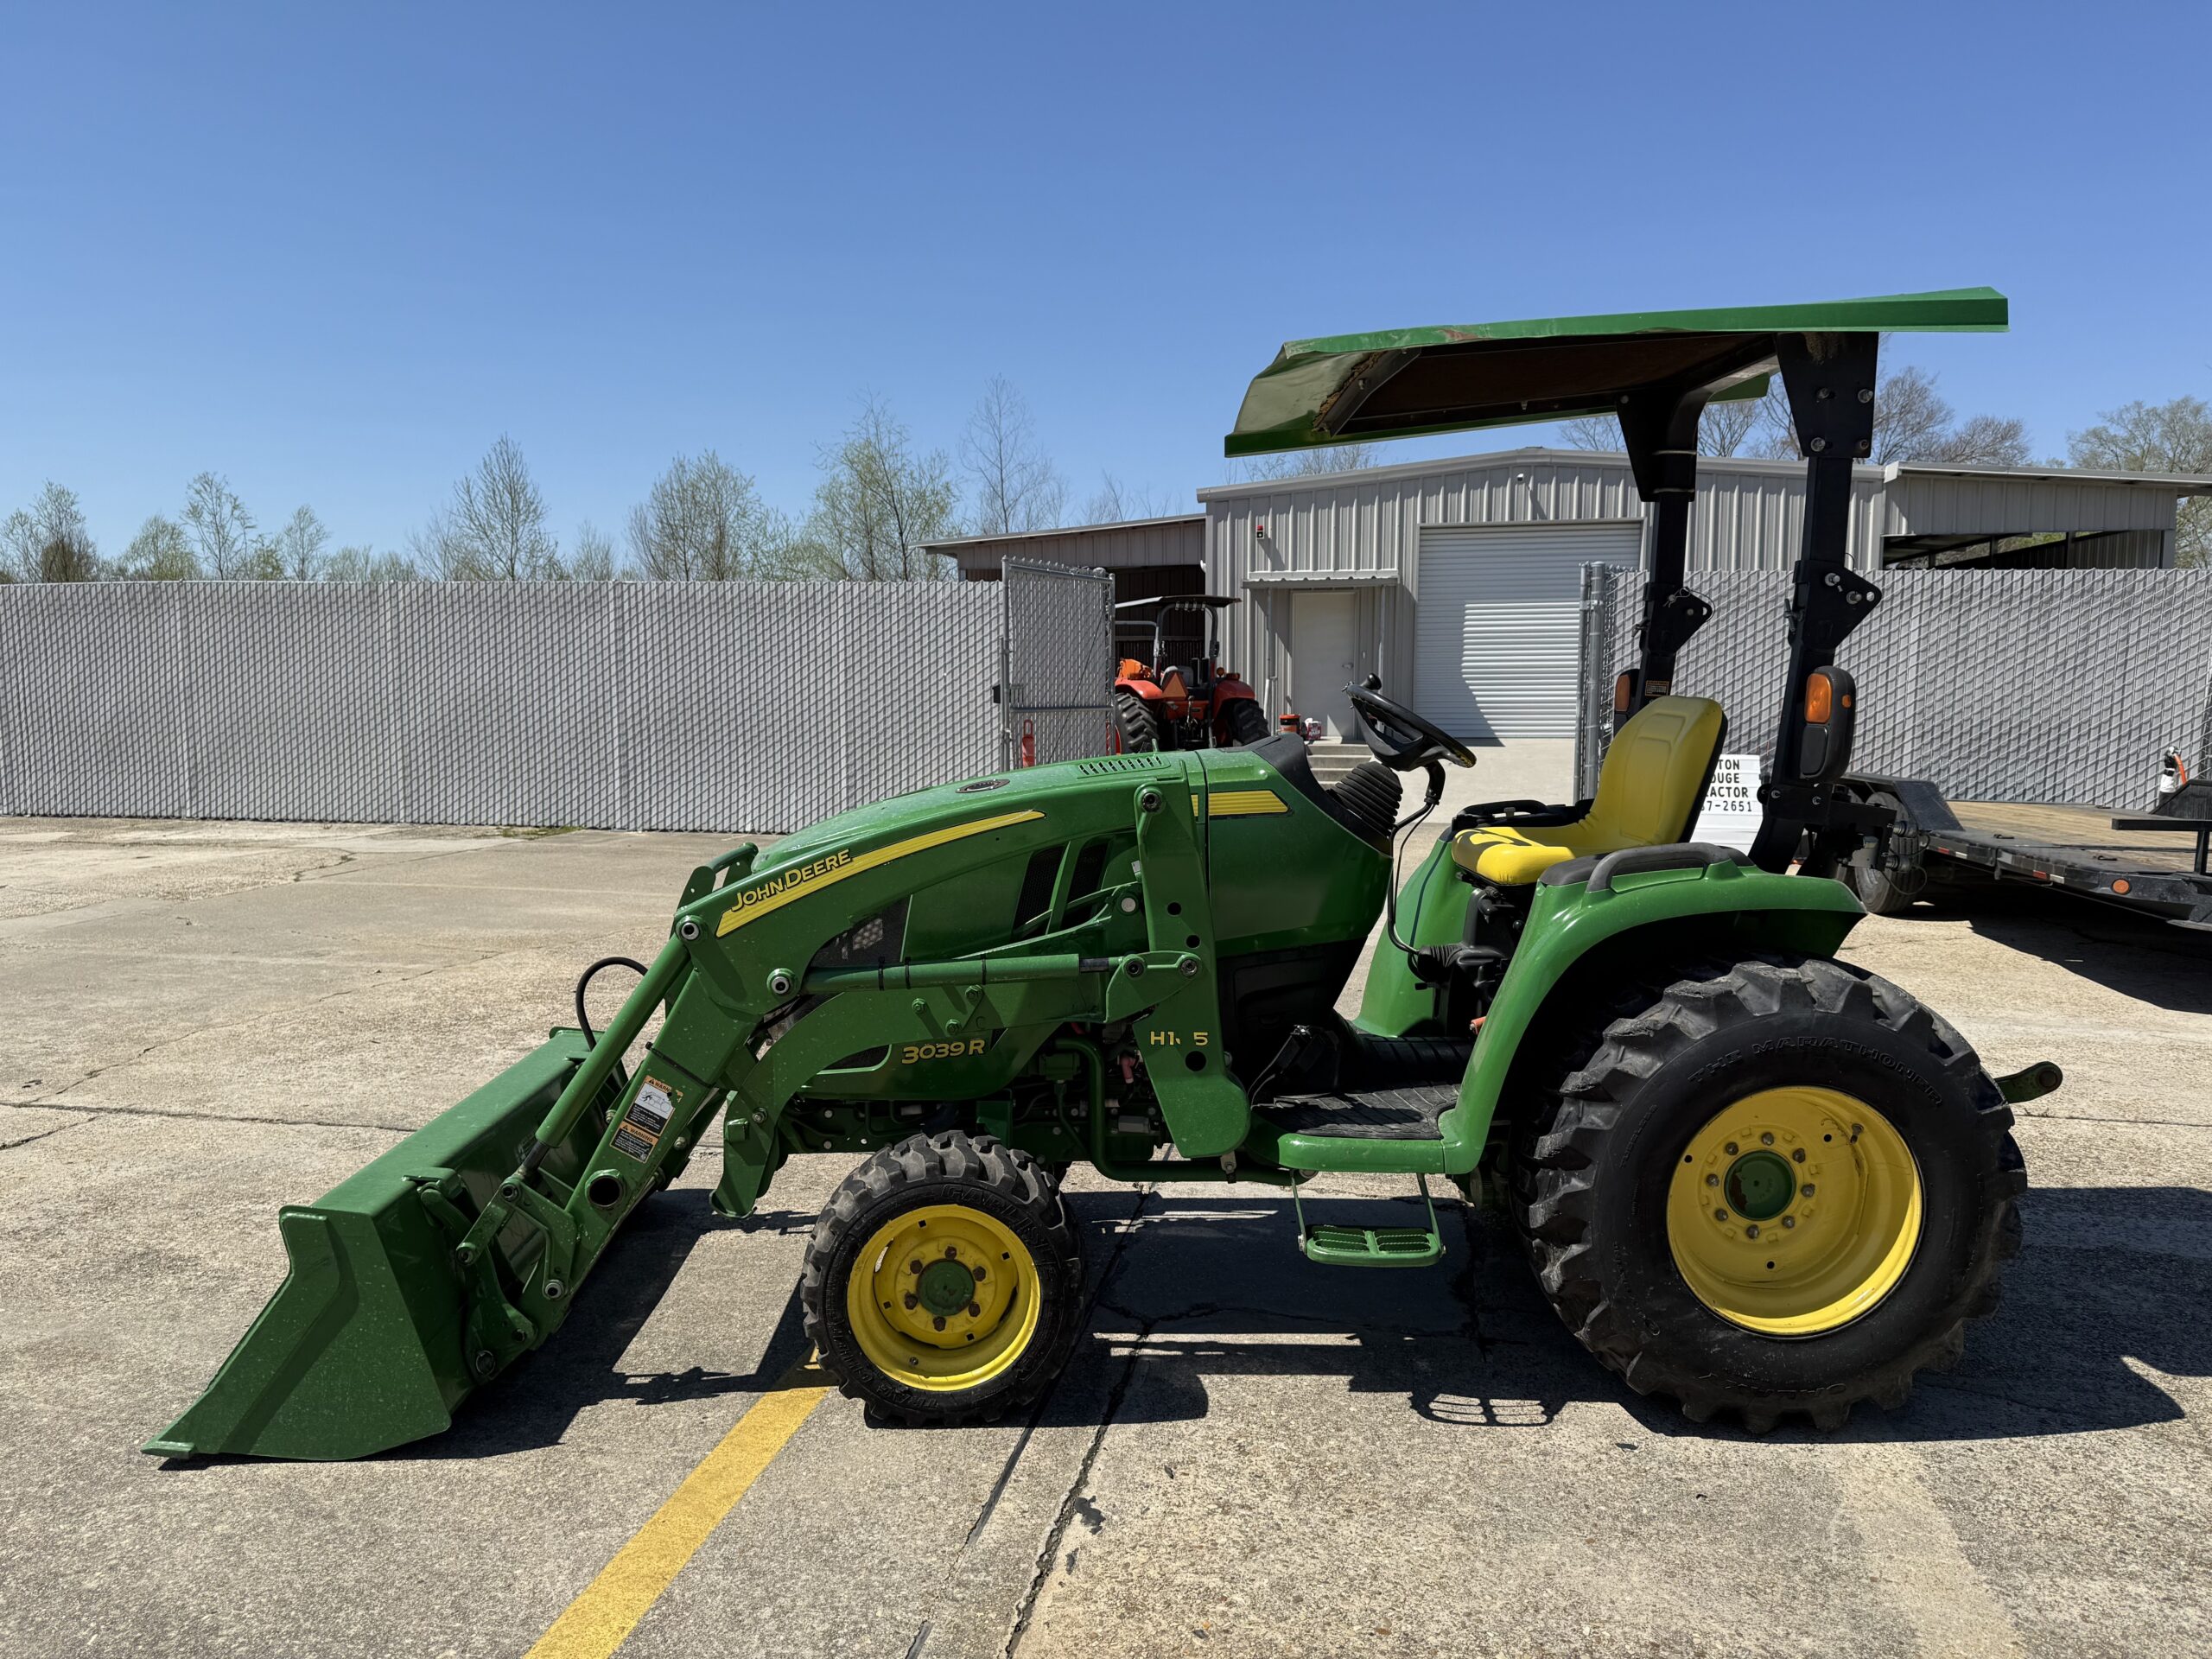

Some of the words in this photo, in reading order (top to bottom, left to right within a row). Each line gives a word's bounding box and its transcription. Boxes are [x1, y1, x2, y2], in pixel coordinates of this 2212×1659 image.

[1706, 786, 1749, 798] ACTOR
[731, 877, 784, 912] JOHN
[784, 849, 853, 889] DEERE
[1149, 1031, 1209, 1046] H15
[655, 1081, 671, 1092] WARN
[630, 1128, 653, 1142] WARNING
